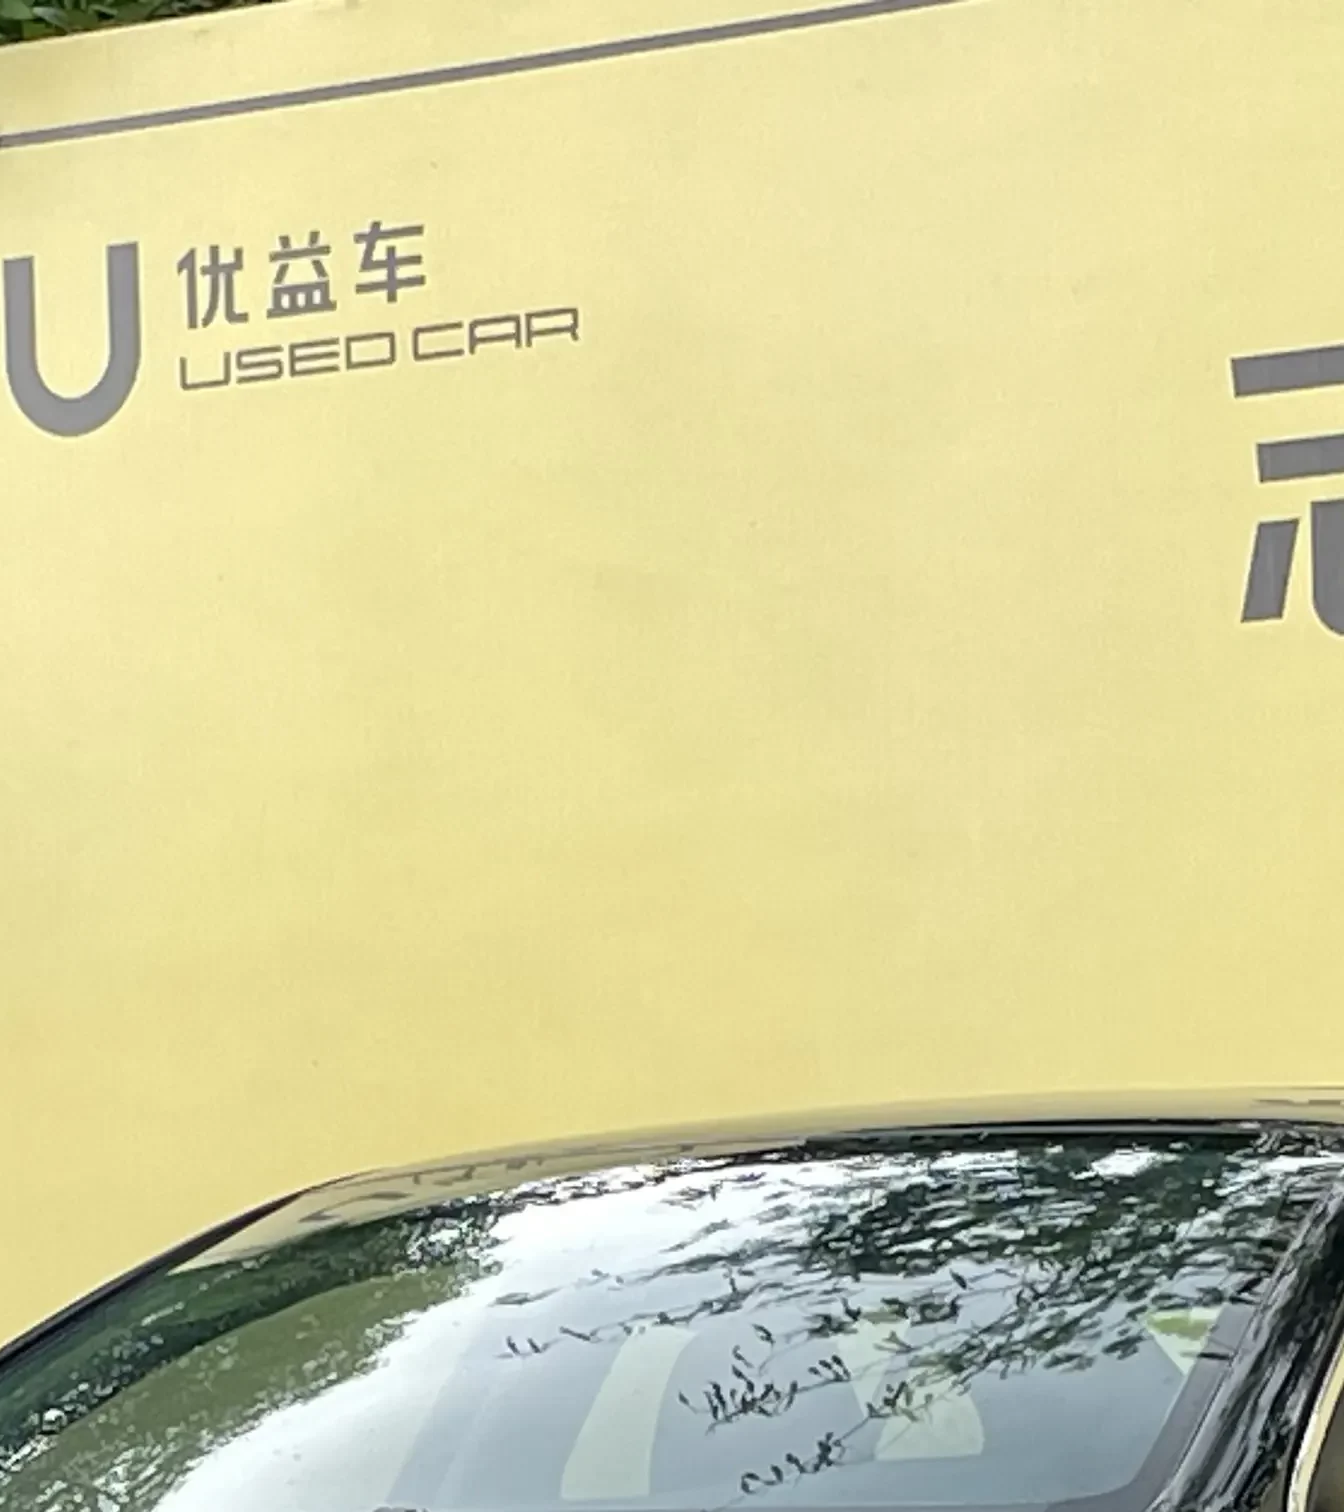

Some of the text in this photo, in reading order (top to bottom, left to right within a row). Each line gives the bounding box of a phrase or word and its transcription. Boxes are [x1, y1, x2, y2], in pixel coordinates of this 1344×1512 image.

[176, 221, 427, 329] 优益车
[179, 307, 580, 391] USED CAR
